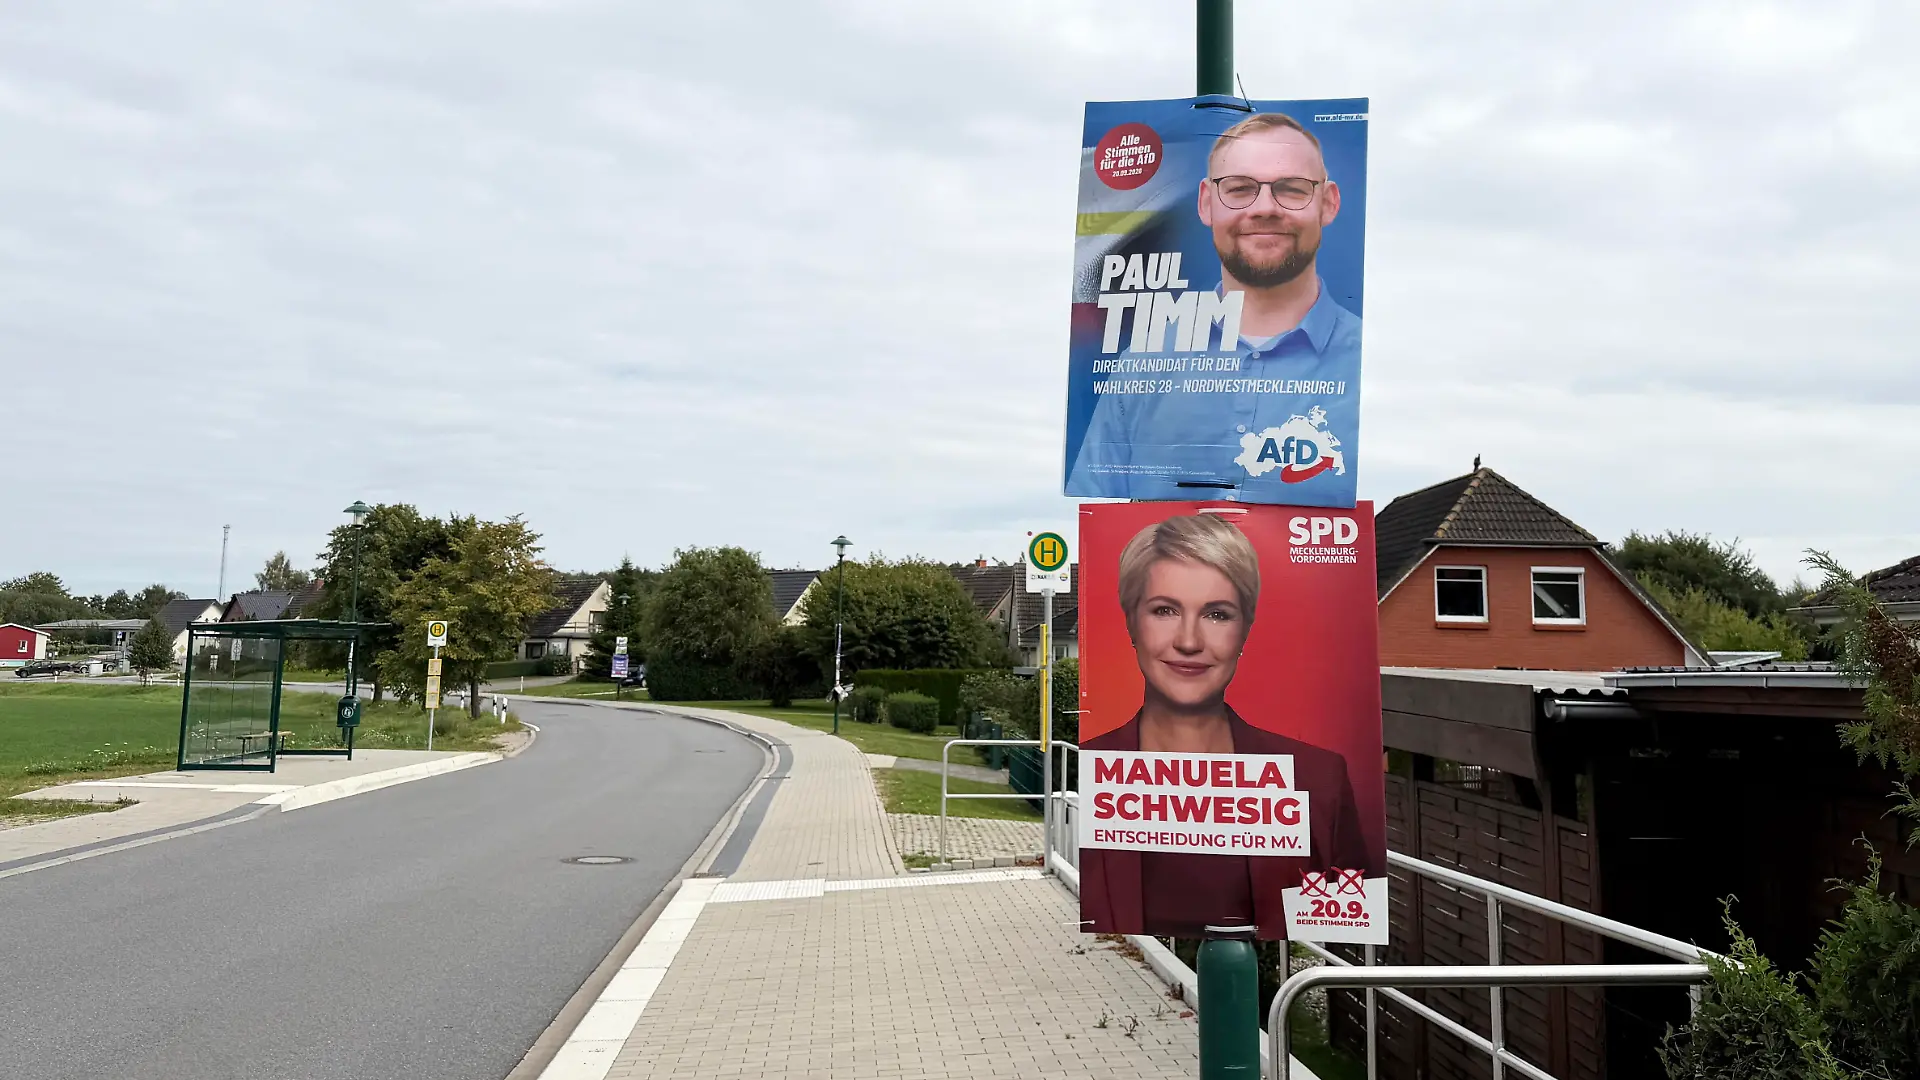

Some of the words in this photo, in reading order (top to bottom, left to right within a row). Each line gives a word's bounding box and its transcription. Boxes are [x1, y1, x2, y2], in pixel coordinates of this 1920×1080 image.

[1120, 135, 1140, 147] Alle
[1100, 159, 1116, 171] für
[1118, 156, 1134, 168] die
[1137, 152, 1156, 165] AfD
[1105, 145, 1151, 159] Stimmen
[1100, 252, 1189, 291] PAUL
[1097, 291, 1245, 354] TIMM
[1092, 358, 1188, 374] DIREKTKANDIDAT
[1190, 355, 1213, 371] FÜR
[1215, 358, 1240, 371] DEN
[1093, 380, 1156, 394] WAHLKREIS
[1158, 380, 1172, 393] 28
[1183, 379, 1335, 394] NORDWESTMECKLENBURG
[1337, 381, 1346, 395] II
[1256, 436, 1319, 465] AfD
[1288, 516, 1359, 546] SPD
[1041, 541, 1056, 563] H
[1289, 547, 1359, 556] MECKLENBURG-
[1290, 555, 1357, 564] VORPOMMERN
[1094, 757, 1287, 789] MANUELA
[1093, 792, 1301, 826] SCHWESIG
[1094, 829, 1226, 848] ENTSCHEIDUNG
[1231, 832, 1266, 849] FÜR
[1271, 834, 1302, 849] MV.
[1310, 899, 1369, 920] 20.9.
[1319, 919, 1353, 927] STIMMEN
